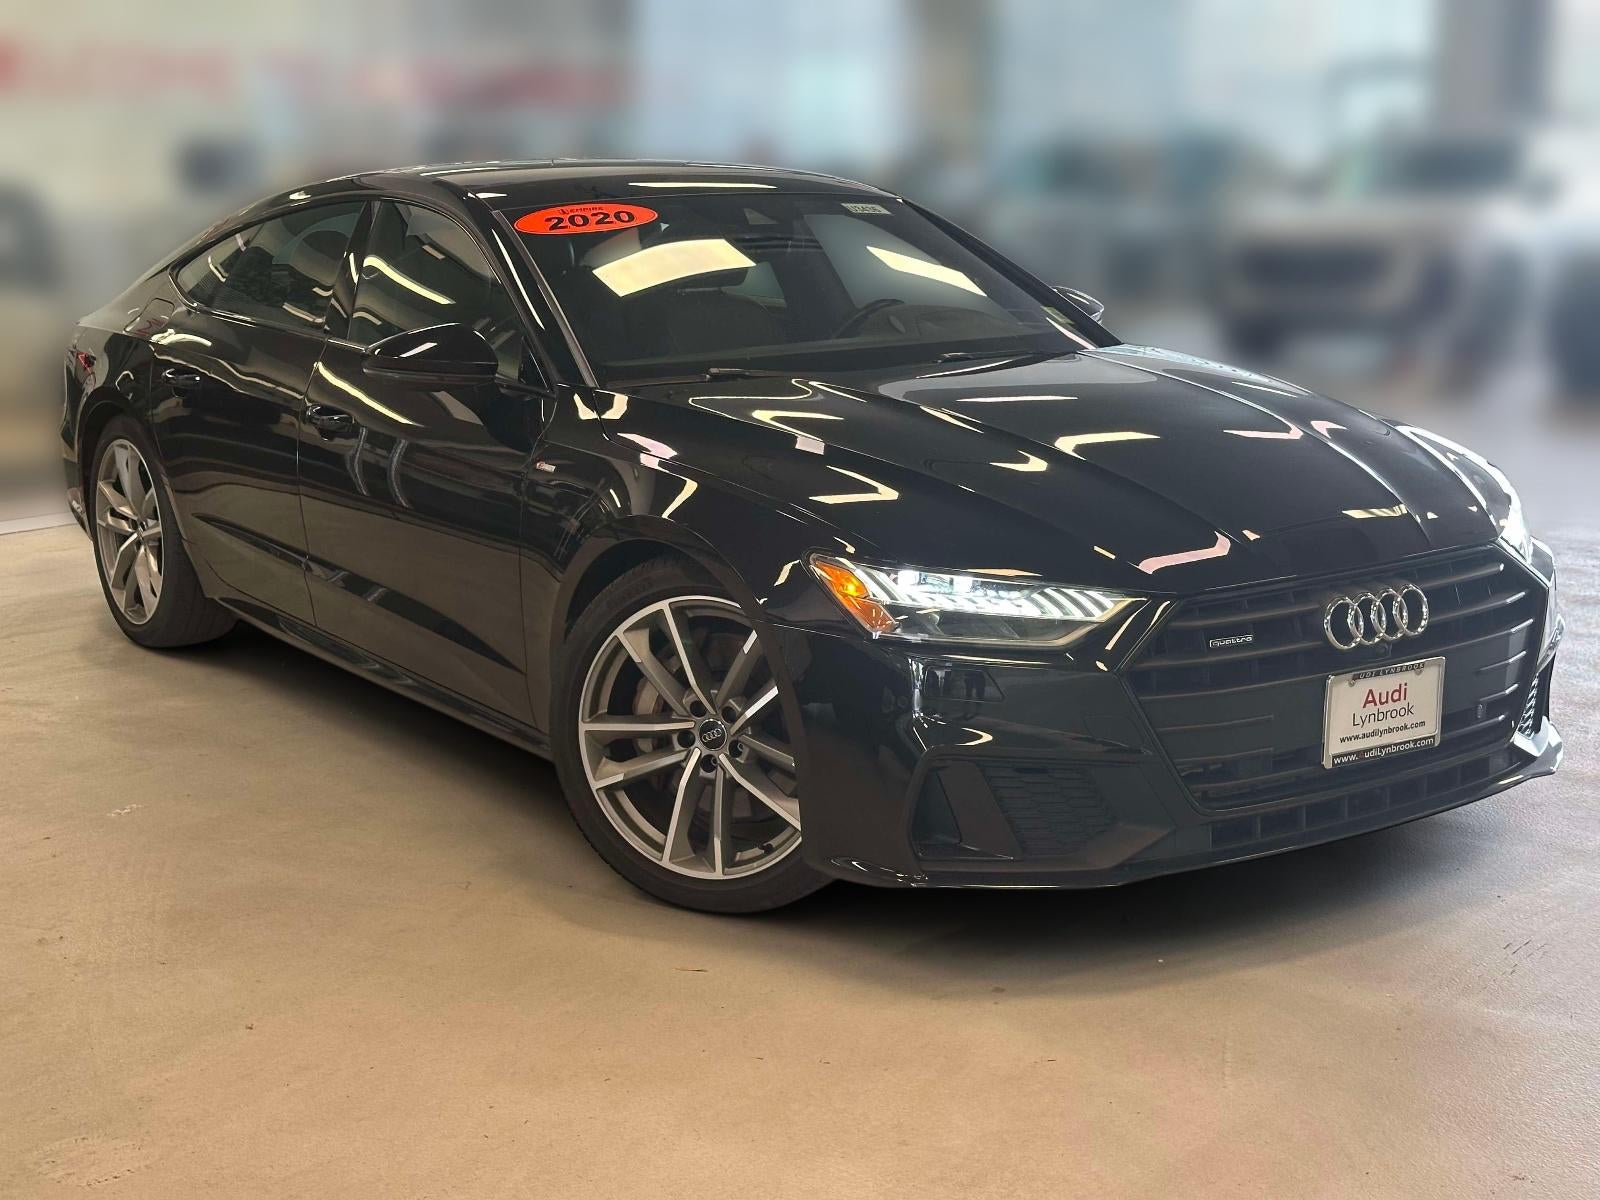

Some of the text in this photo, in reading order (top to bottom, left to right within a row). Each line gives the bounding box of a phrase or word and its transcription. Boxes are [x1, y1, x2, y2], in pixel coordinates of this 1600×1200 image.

[544, 210, 635, 231] 2020
[1212, 636, 1253, 647] quattro
[1379, 662, 1425, 676] LYNBROOK
[1362, 682, 1408, 709] Audi
[1352, 702, 1415, 728] Lynbrook
[1339, 720, 1426, 744] www.audilynbrook.com
